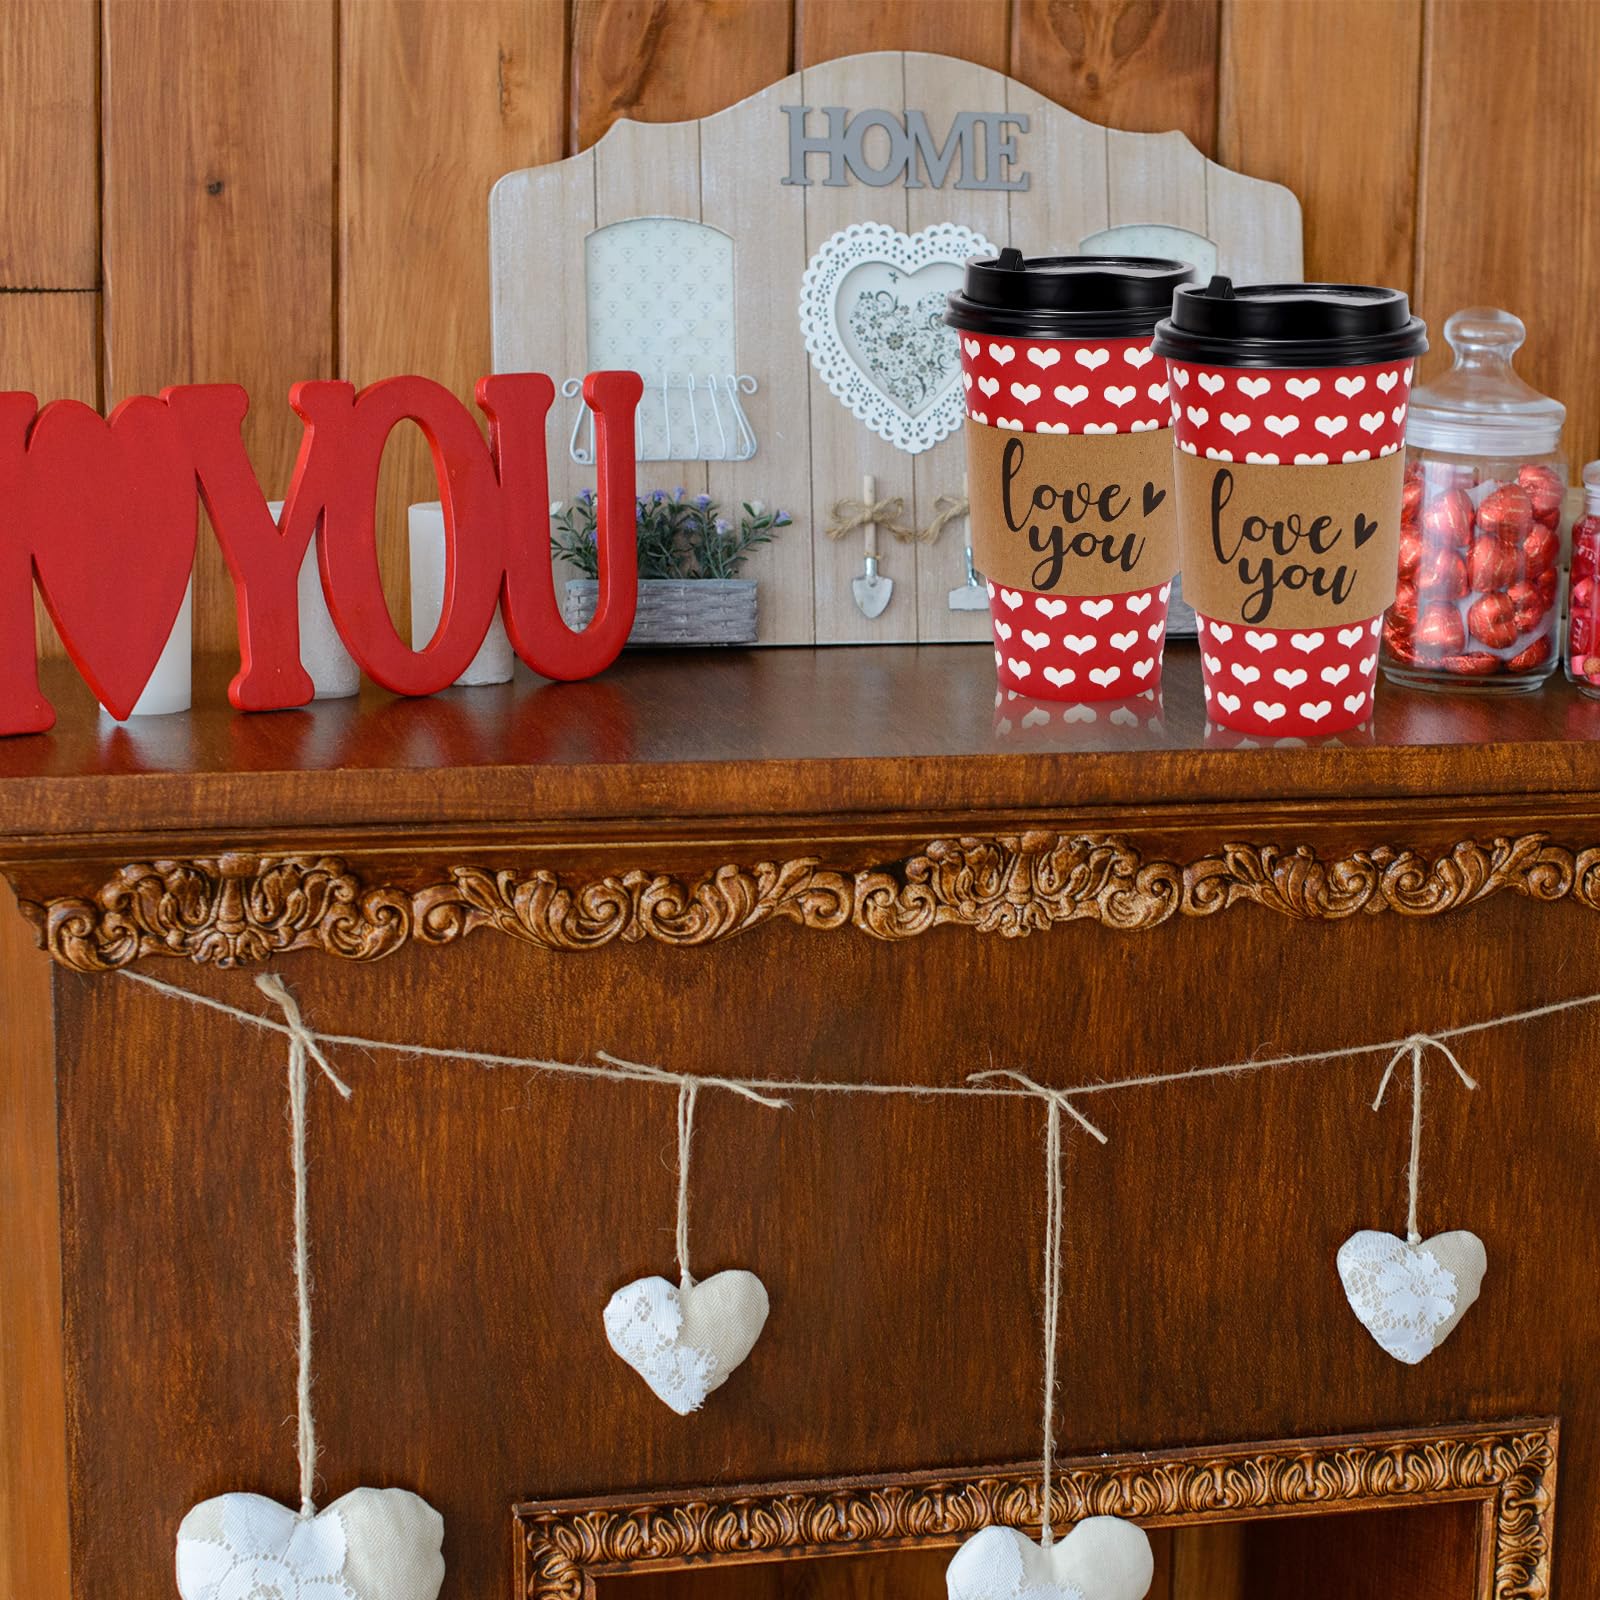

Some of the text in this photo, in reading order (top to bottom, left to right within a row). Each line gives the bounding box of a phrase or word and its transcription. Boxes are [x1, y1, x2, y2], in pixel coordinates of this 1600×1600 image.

[780, 105, 1030, 191] HOME
[1002, 437, 1131, 532] love
[1211, 468, 1342, 564] love
[160, 371, 644, 713] YOU
[1028, 525, 1146, 591] you
[1238, 557, 1357, 624] you
